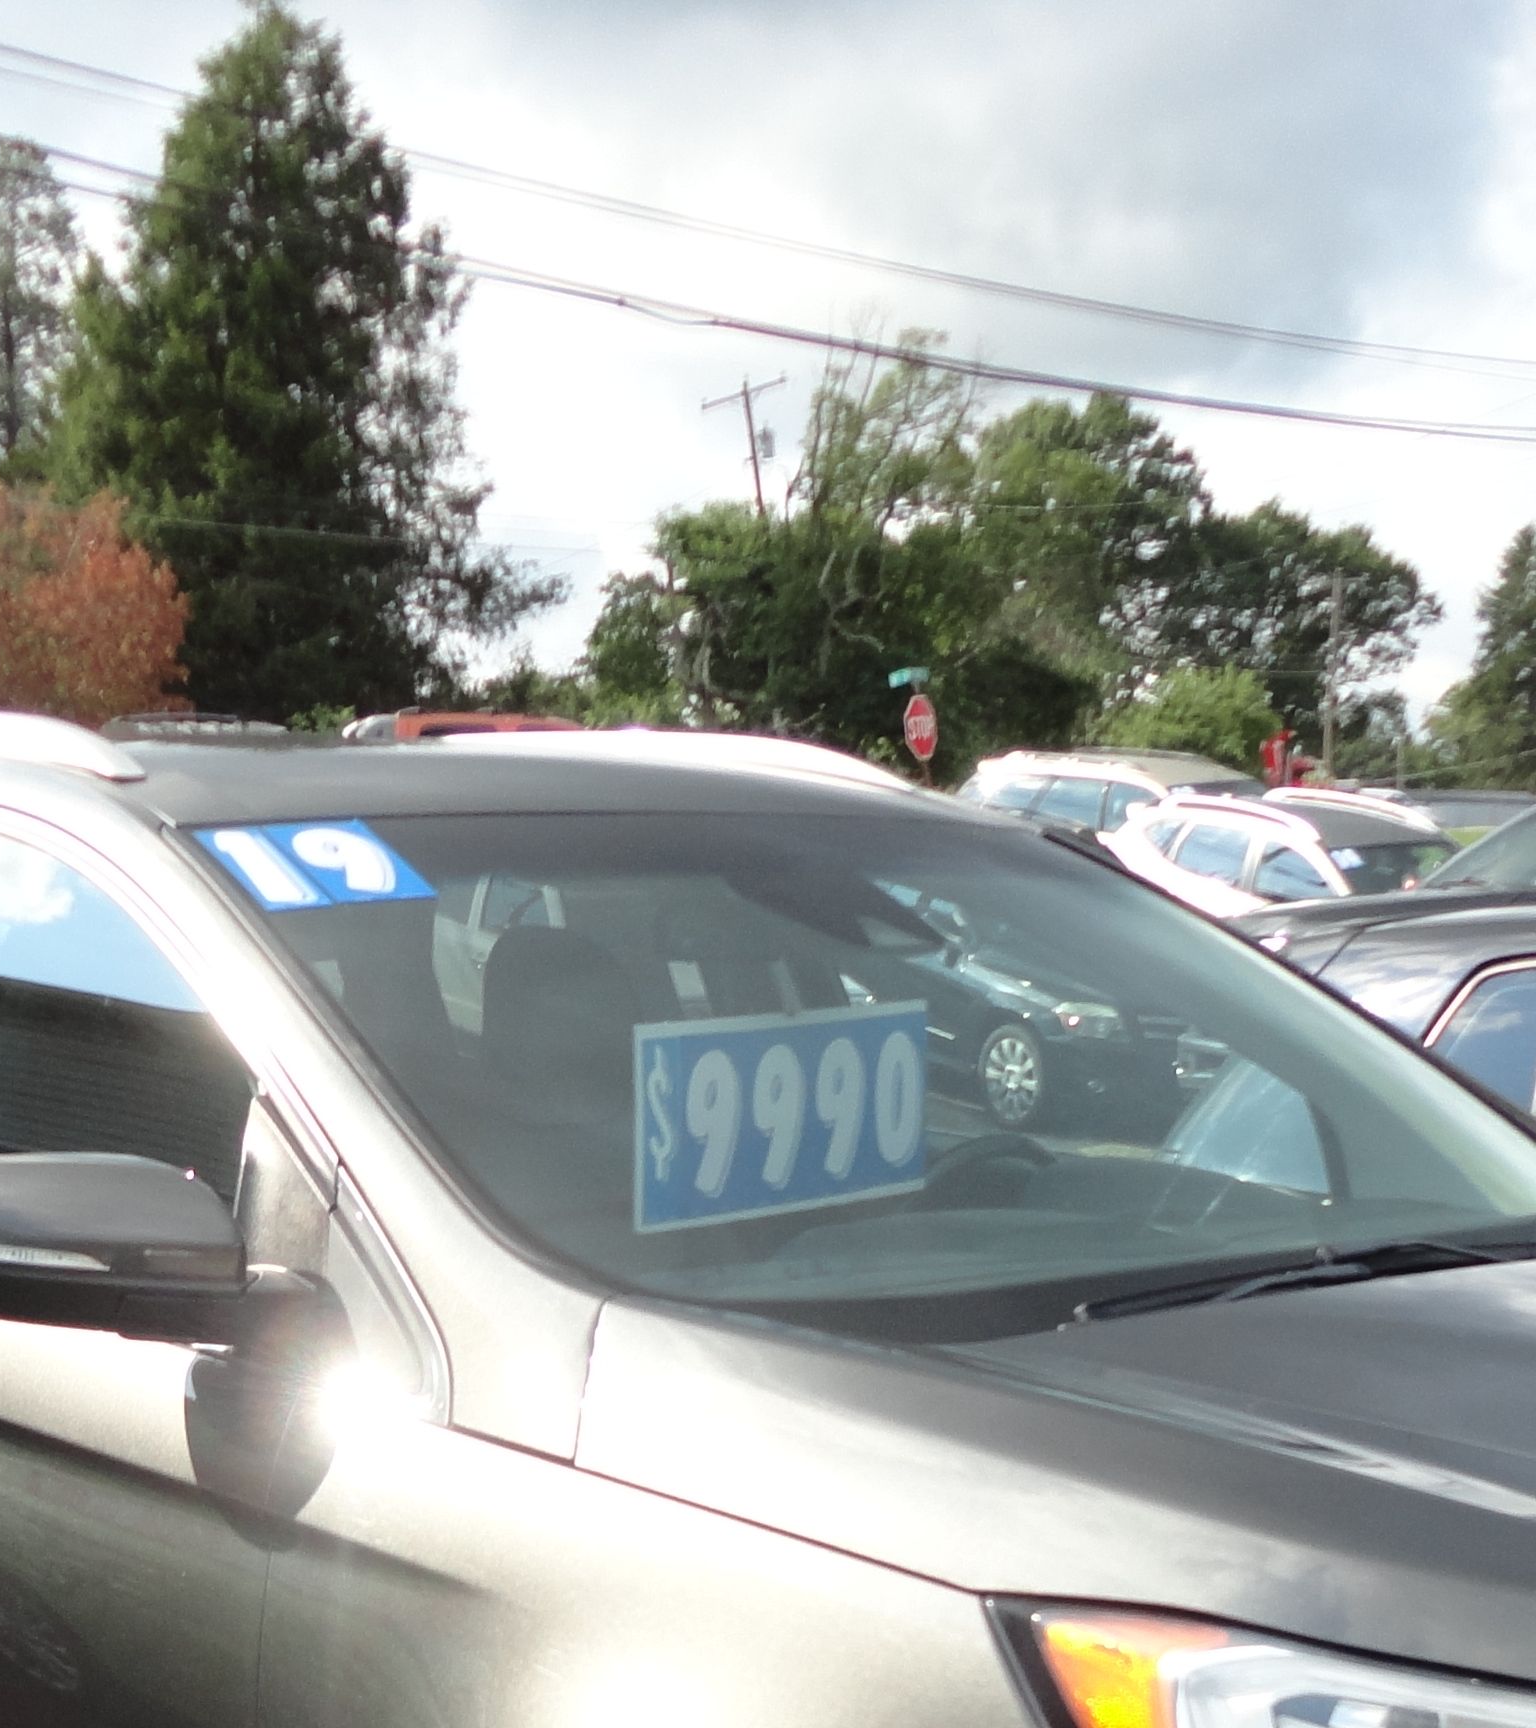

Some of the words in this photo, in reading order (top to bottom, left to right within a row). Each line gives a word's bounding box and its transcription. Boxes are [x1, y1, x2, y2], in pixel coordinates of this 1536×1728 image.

[907, 715, 935, 740] STOP
[213, 828, 396, 903] 19
[647, 1030, 923, 1198] $9990
